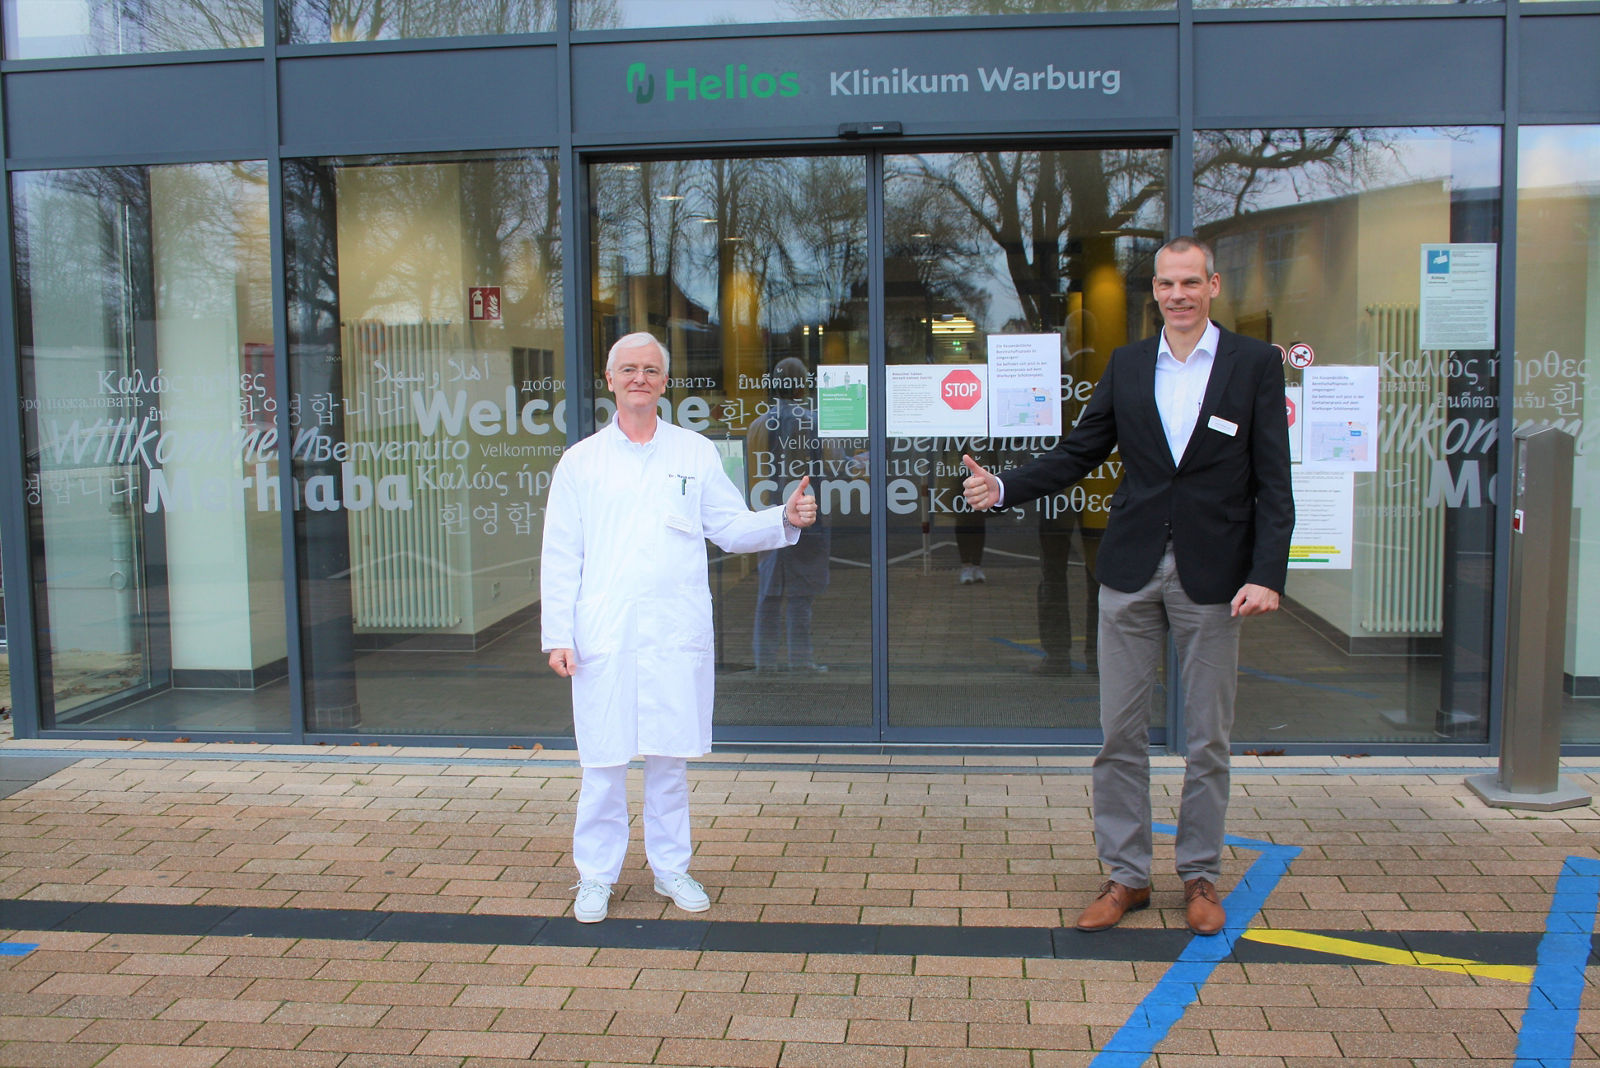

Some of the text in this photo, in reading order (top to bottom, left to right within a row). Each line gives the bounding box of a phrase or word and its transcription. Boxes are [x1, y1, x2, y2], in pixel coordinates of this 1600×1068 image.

[666, 64, 800, 100] Helios
[829, 63, 1121, 96] Klinikum Warburg
[943, 382, 978, 398] STOP
[314, 435, 470, 462] Benvenuto
